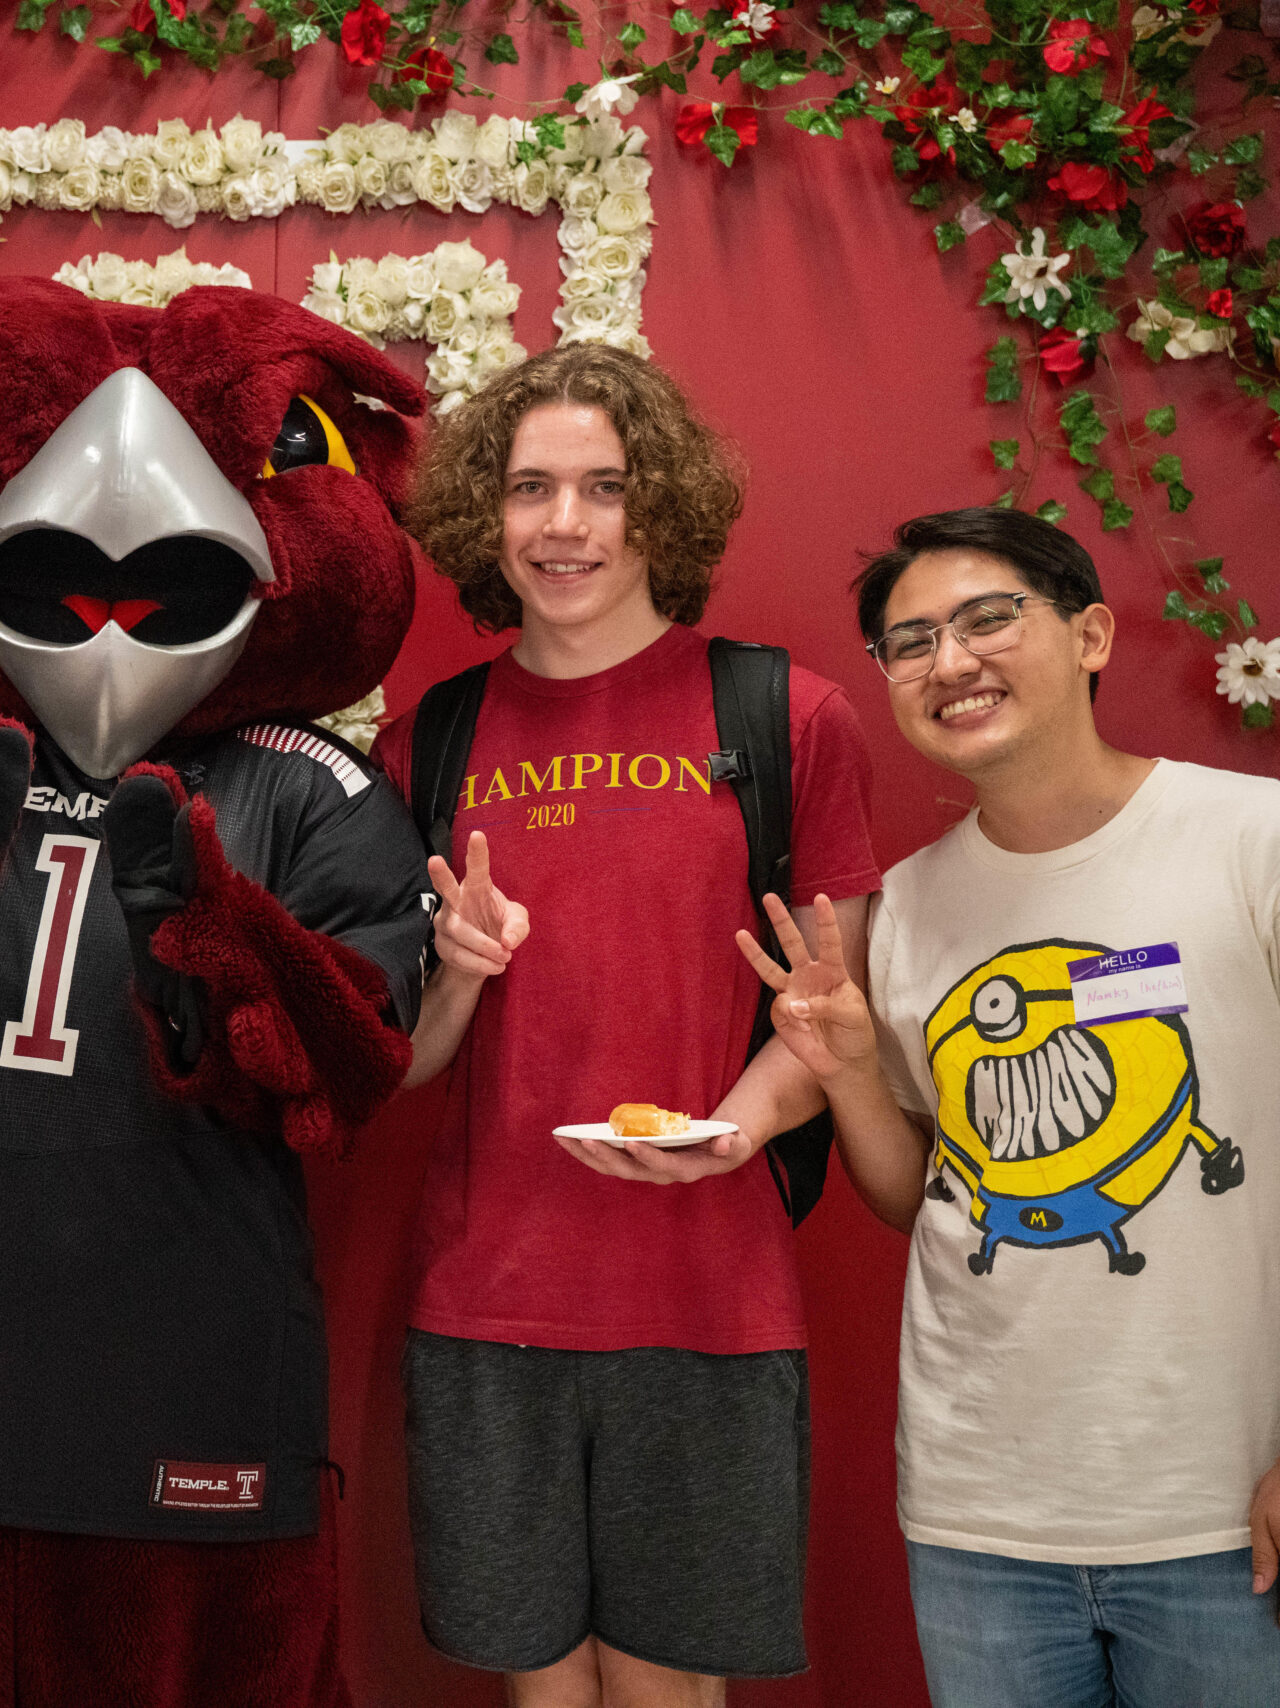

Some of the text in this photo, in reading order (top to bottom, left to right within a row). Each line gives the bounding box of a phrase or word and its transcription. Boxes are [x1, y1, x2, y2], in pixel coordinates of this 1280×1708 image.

[457, 752, 712, 811] HAMPION
[22, 786, 110, 821] EMP
[526, 802, 576, 830] 2020
[1099, 951, 1148, 970] HELLO
[1030, 1211, 1047, 1227] M
[153, 1465, 165, 1502] AUTHENTIC
[169, 1477, 228, 1490] TEMPLE
